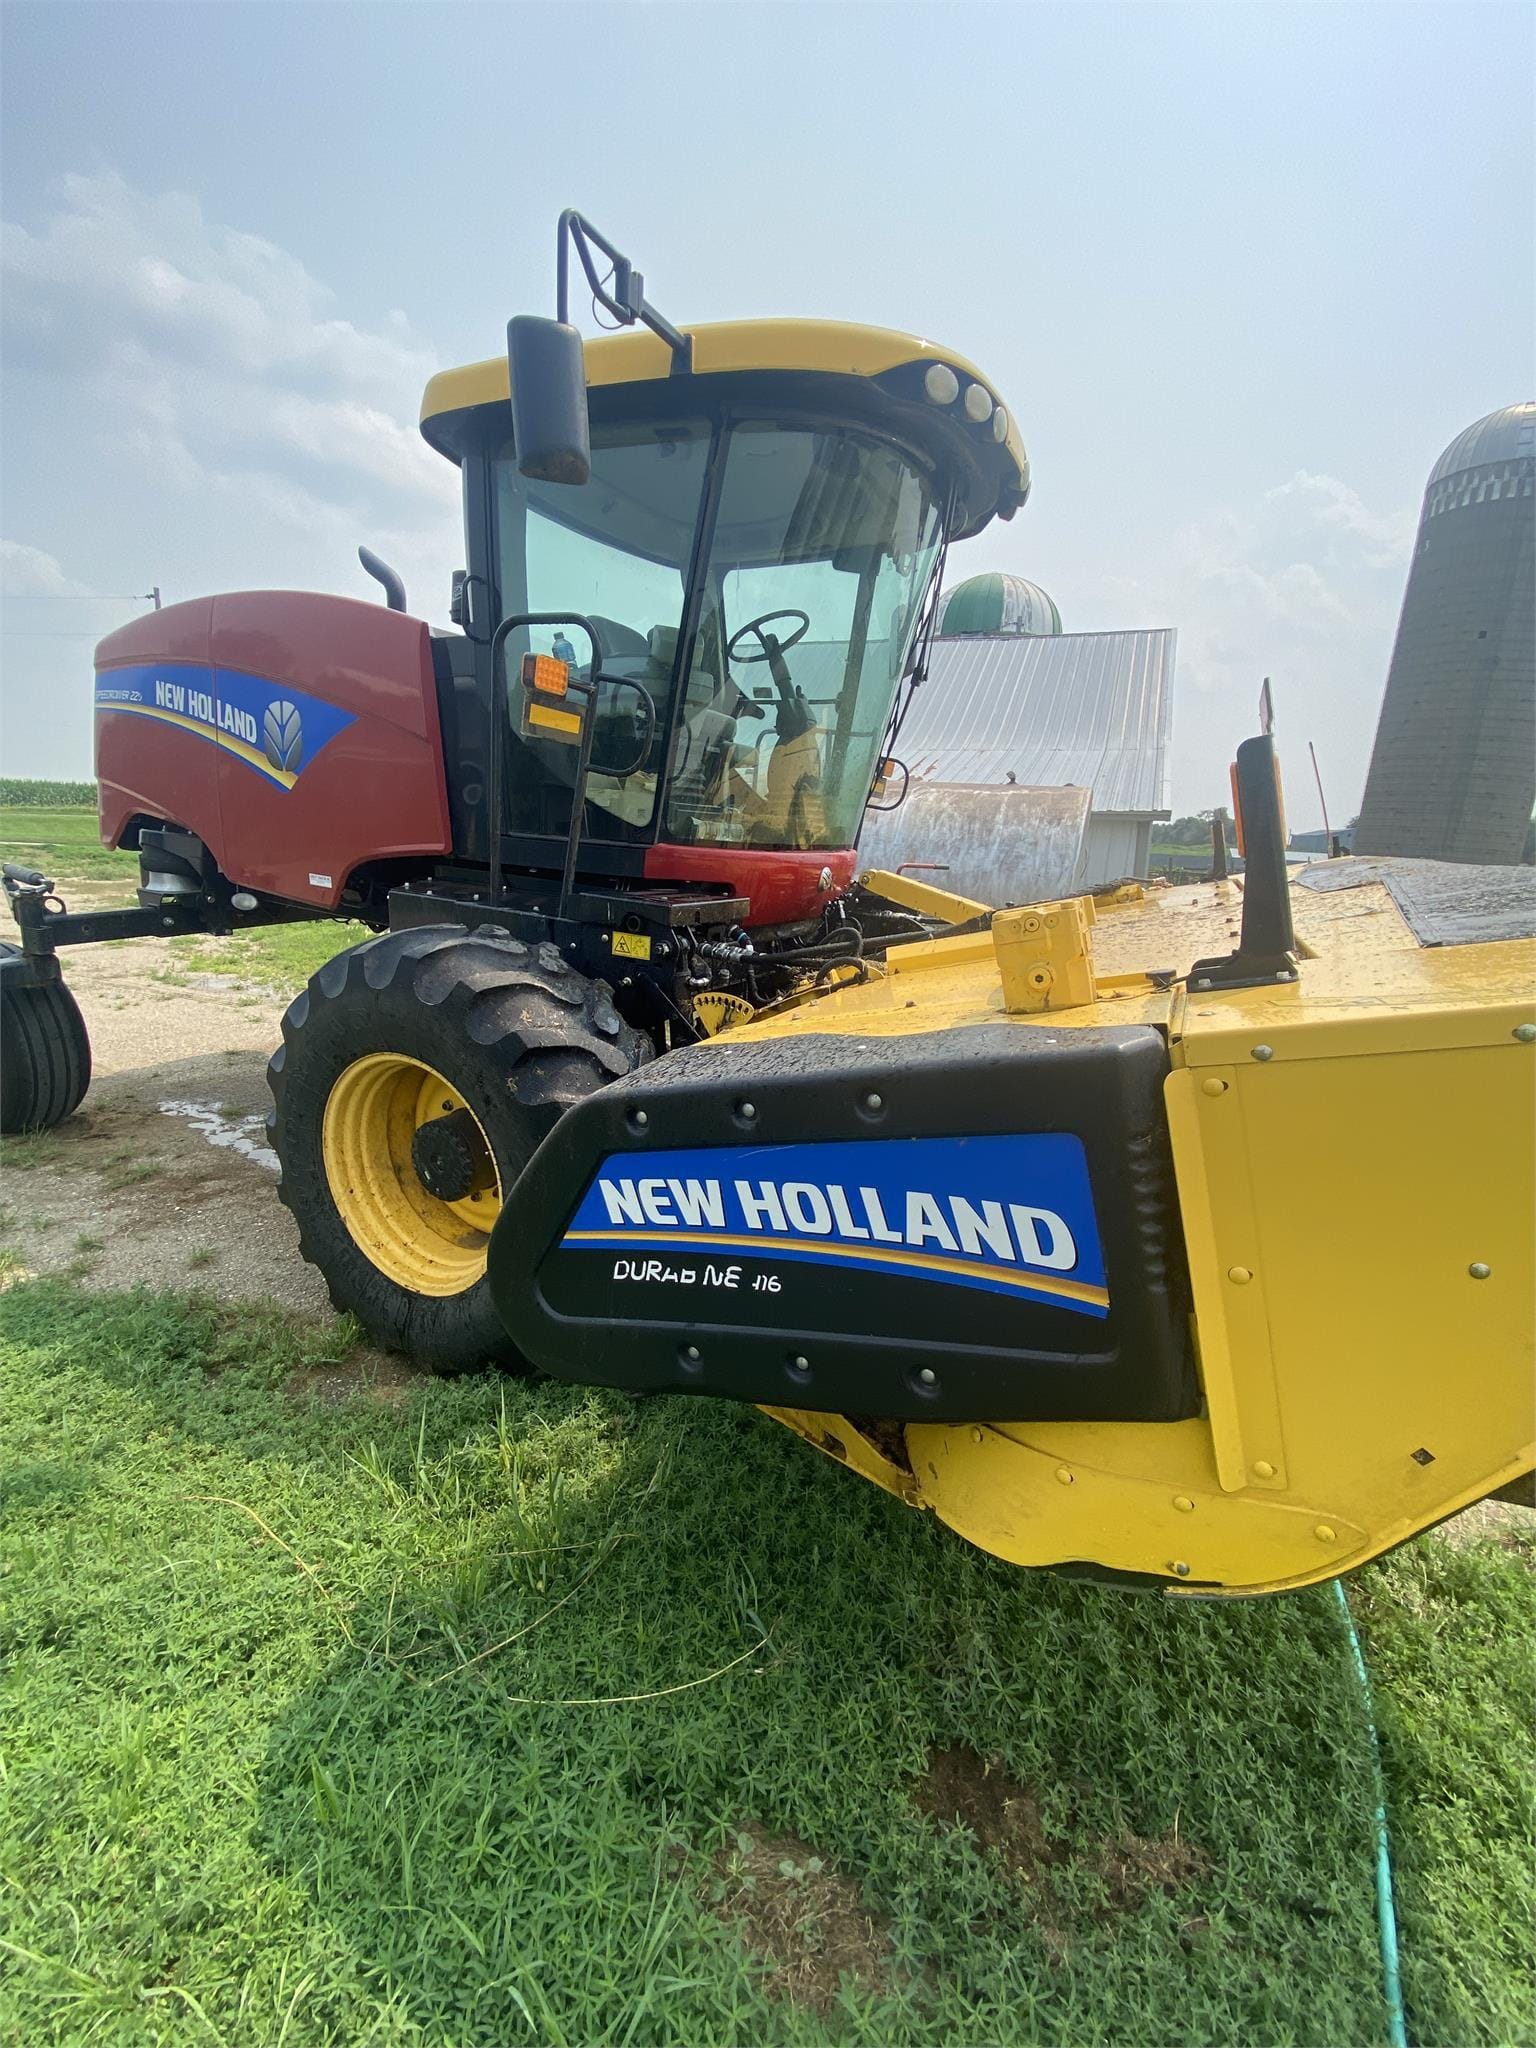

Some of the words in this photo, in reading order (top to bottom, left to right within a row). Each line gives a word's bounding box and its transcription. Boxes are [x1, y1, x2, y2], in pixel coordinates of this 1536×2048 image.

[155, 680, 185, 712] NEW
[187, 688, 257, 744] HOLLAND
[598, 1178, 726, 1228] NEW
[733, 1179, 1078, 1271] HOLLAND
